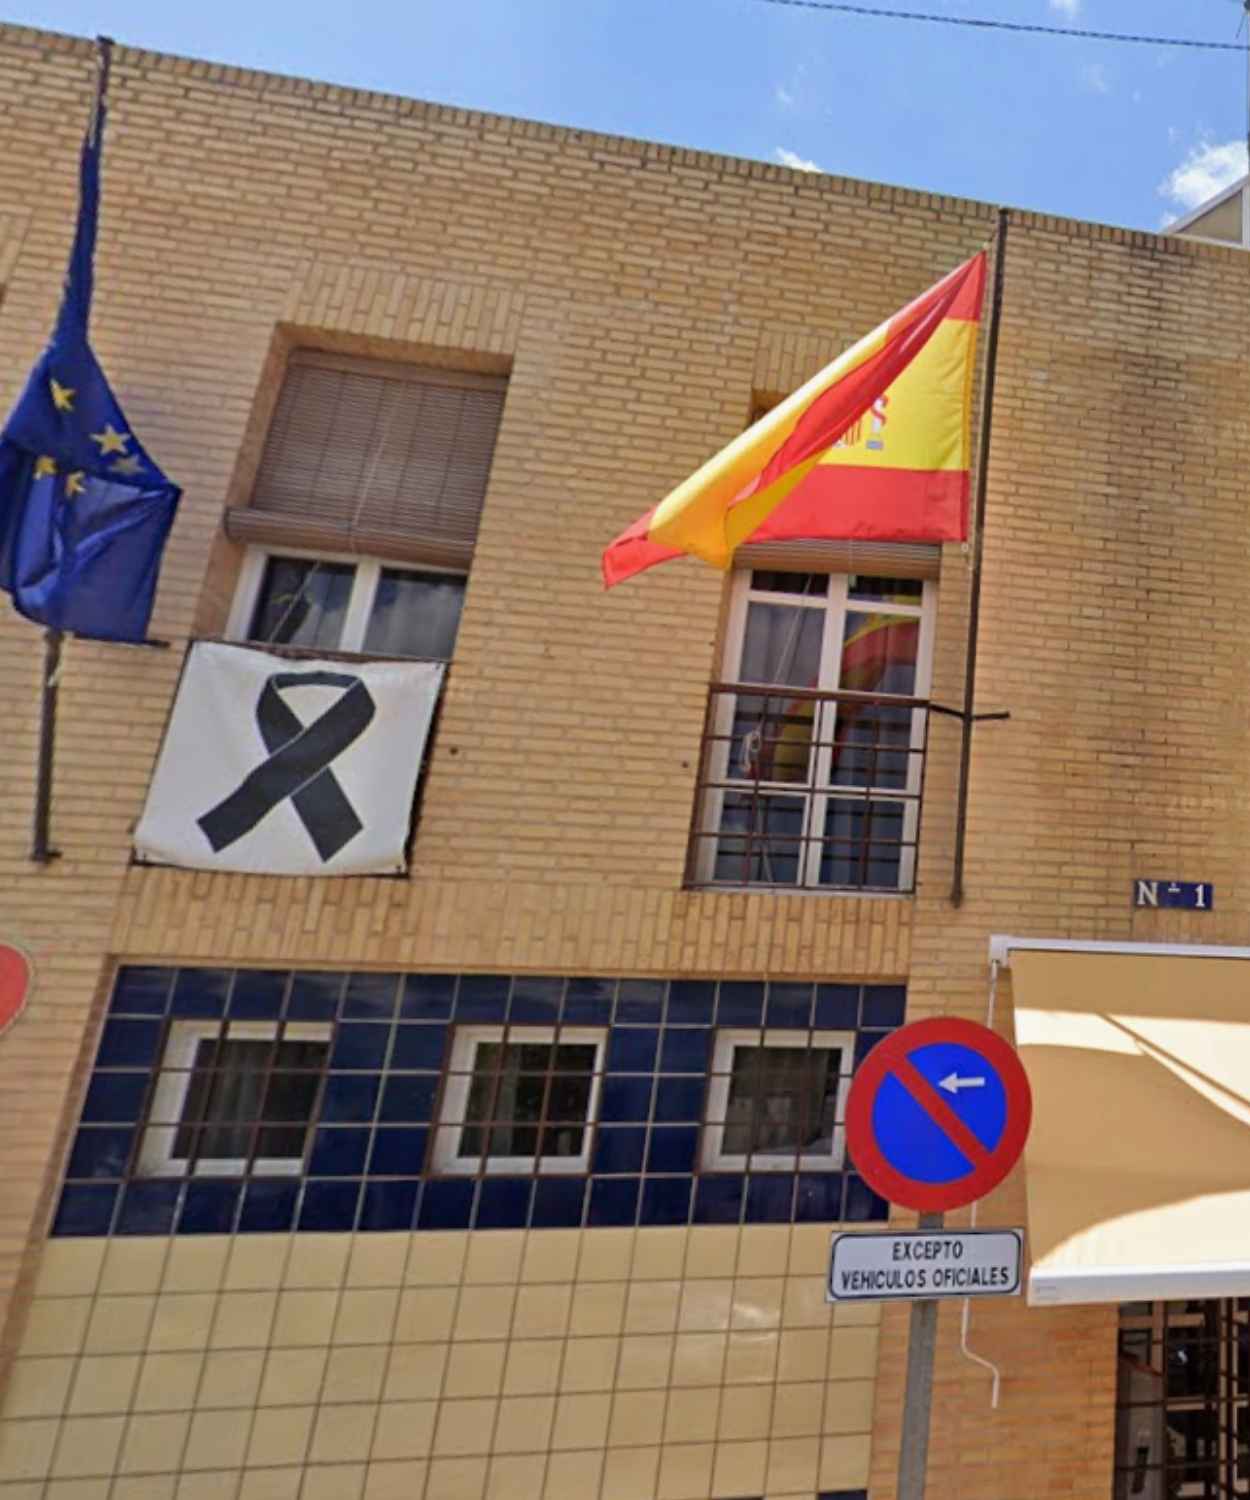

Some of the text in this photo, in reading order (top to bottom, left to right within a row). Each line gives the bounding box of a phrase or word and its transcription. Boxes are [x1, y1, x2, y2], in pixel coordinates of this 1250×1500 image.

[1195, 884, 1206, 908] 1
[892, 1240, 964, 1261] EXCEPTO
[841, 1266, 1010, 1291] VEHICULOS OFICIALES
